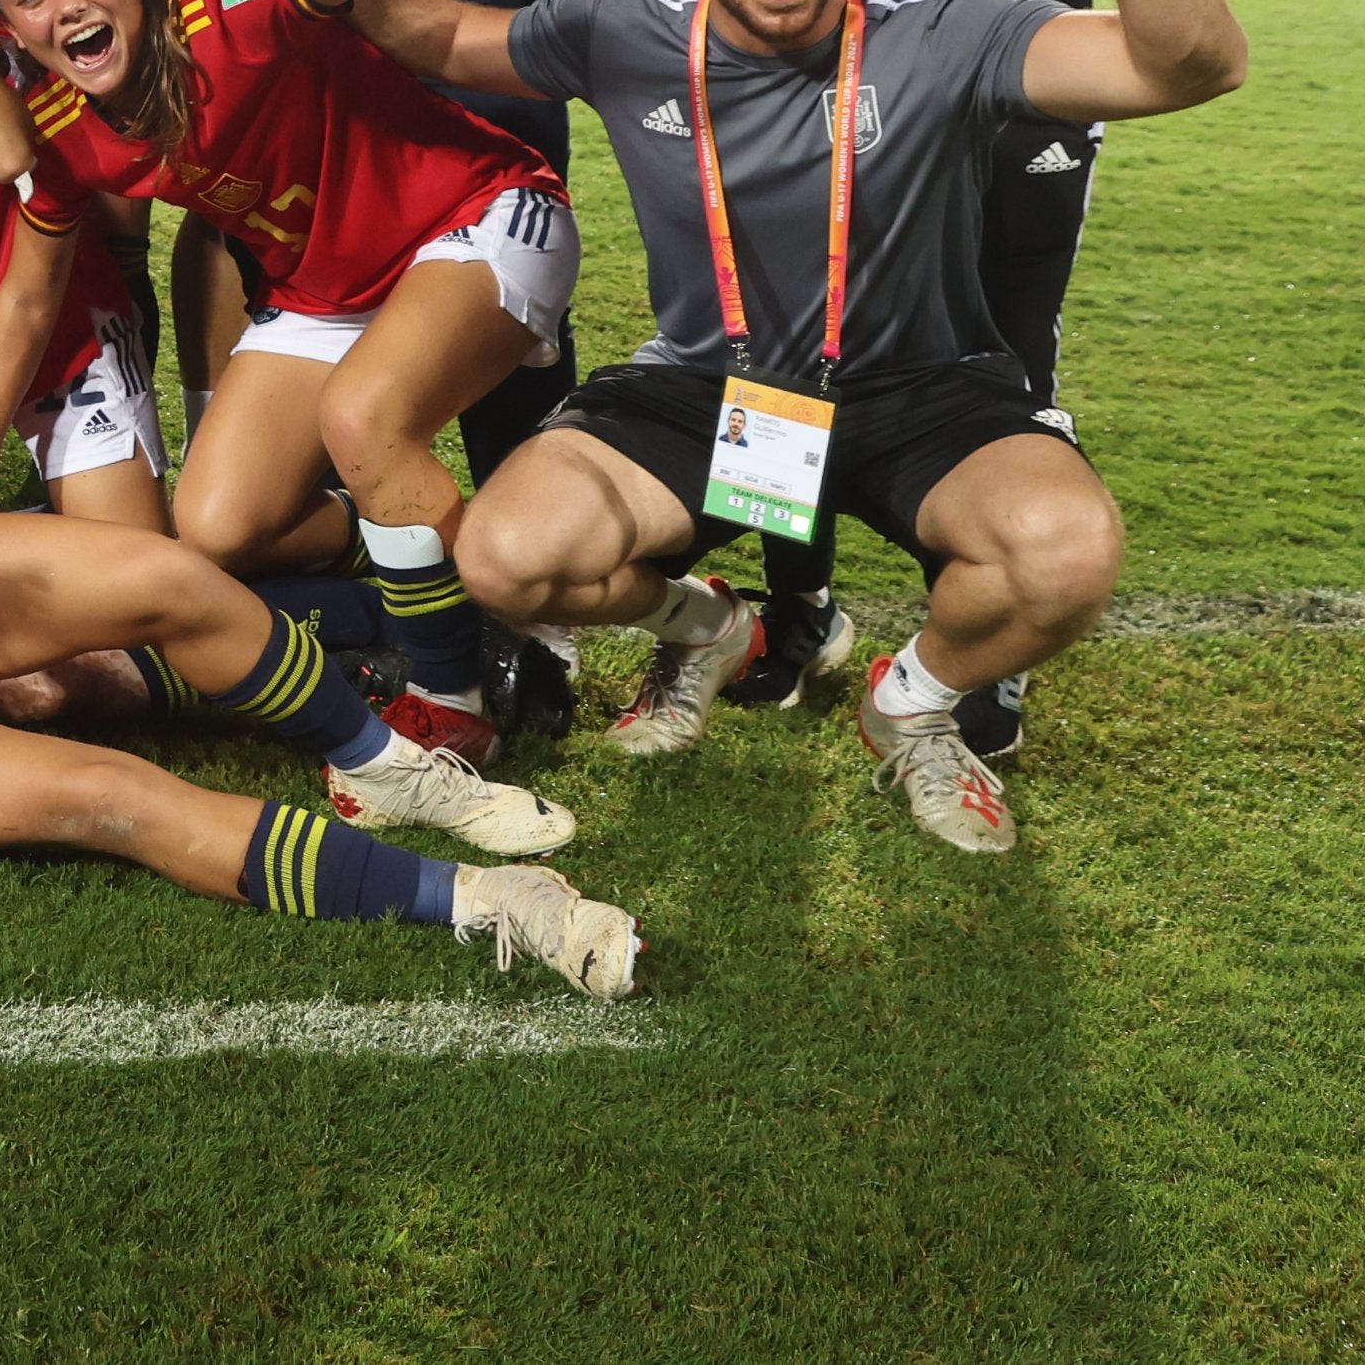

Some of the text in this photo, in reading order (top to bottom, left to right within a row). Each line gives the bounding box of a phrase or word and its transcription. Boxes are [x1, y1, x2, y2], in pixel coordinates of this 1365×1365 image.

[844, 60, 855, 85] INDIA
[694, 77, 702, 96] CUP
[843, 85, 852, 105] CUP
[696, 96, 708, 129] WORLD
[840, 105, 850, 140] WORLD
[642, 116, 692, 138] adidas
[700, 129, 713, 171] WOMEN'S
[837, 140, 849, 183] WOMEN'S
[1025, 159, 1081, 174] adidas
[705, 169, 715, 190] U-17
[709, 189, 719, 209] FIFA
[837, 183, 847, 203] U-17
[836, 202, 845, 222] FIFA
[82, 422, 118, 435] adidas
[732, 487, 752, 500] TEAM
[754, 493, 792, 510] DELEGATE
